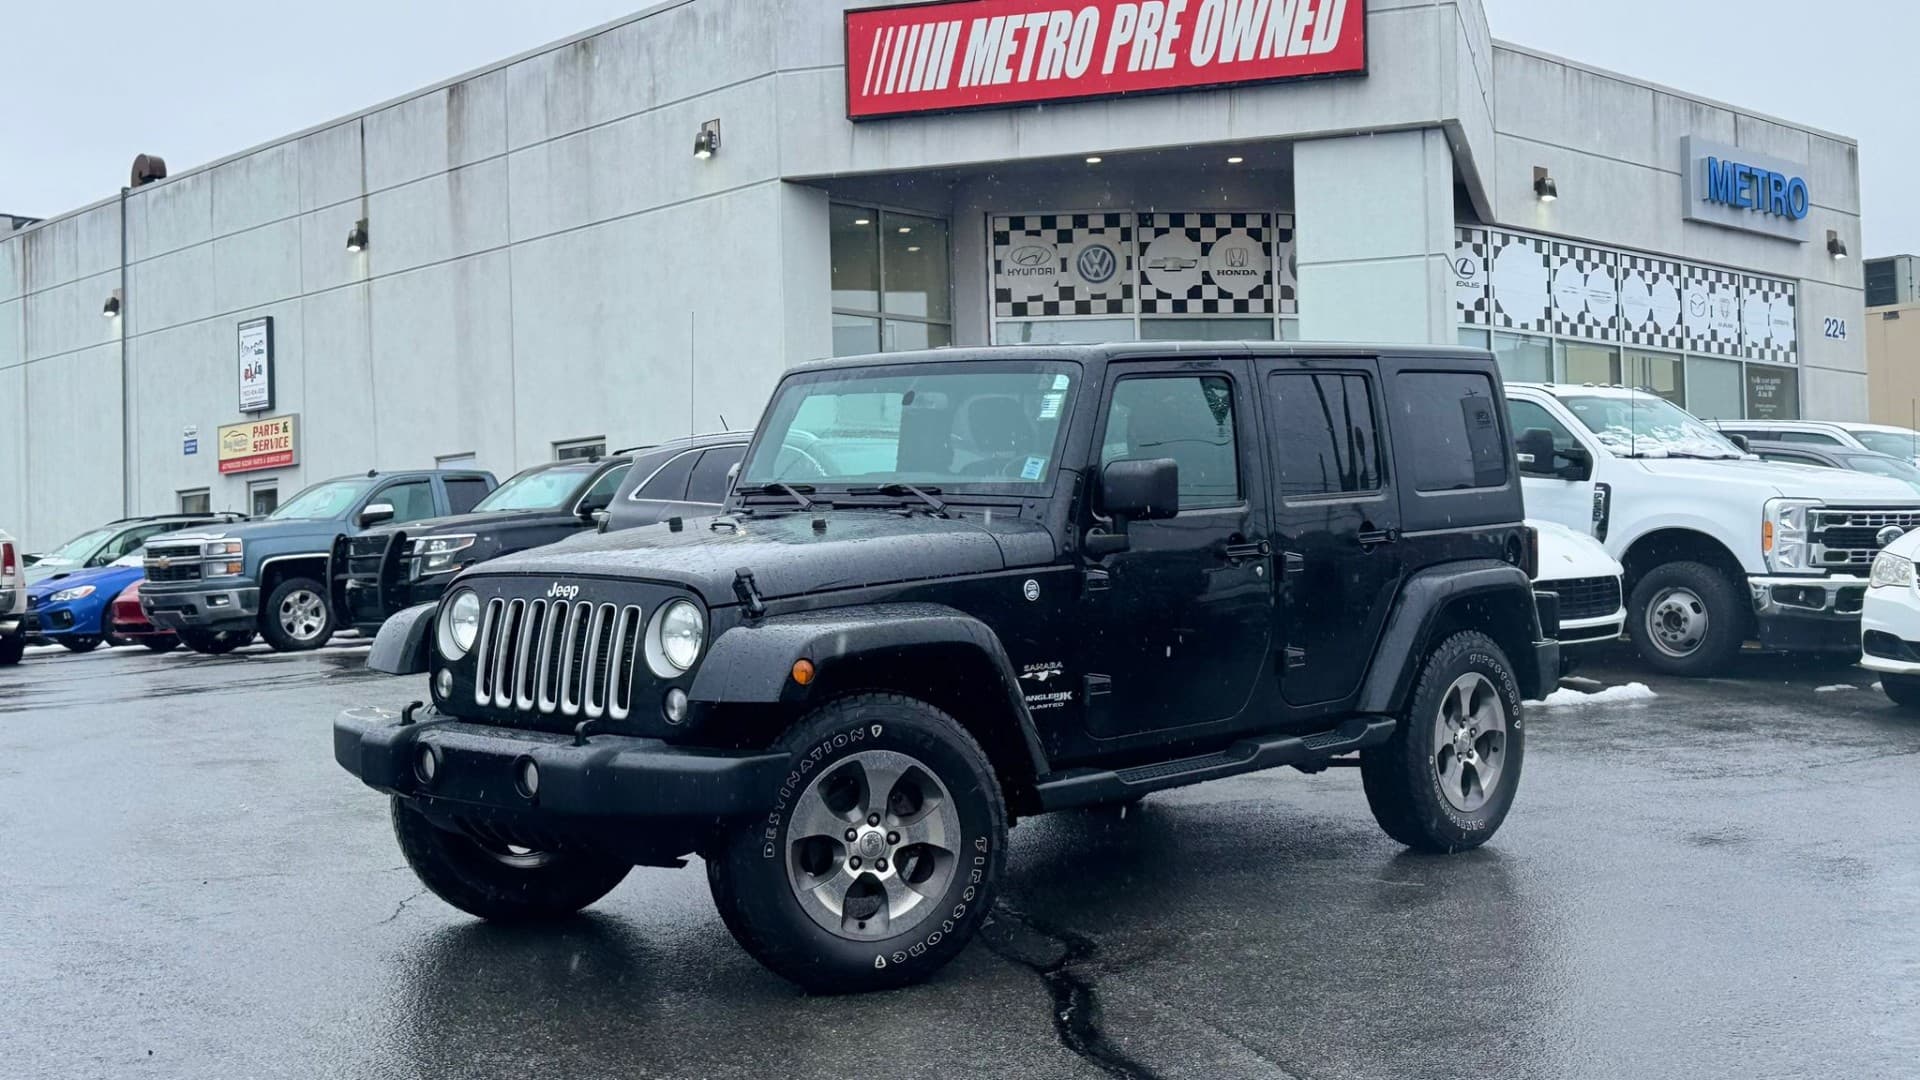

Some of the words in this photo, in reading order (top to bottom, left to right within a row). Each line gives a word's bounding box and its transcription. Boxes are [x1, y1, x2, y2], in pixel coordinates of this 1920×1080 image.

[958, 5, 1101, 89] METRO
[1101, 0, 1188, 76] PRE
[1189, 0, 1347, 68] OWNED
[1706, 155, 1809, 221] METRO
[1007, 267, 1056, 277] HYUNDAI
[1216, 269, 1258, 277] HONDA
[1456, 280, 1481, 289] EXUS
[1824, 317, 1847, 340] 224
[253, 422, 280, 438] PARTS
[282, 421, 289, 433] &
[252, 436, 289, 453] SERVICE
[547, 581, 579, 601] Jeep
[1023, 661, 1064, 672] SAHARA
[1025, 692, 1057, 702] ANGLER
[763, 728, 865, 858] DESTINATION
